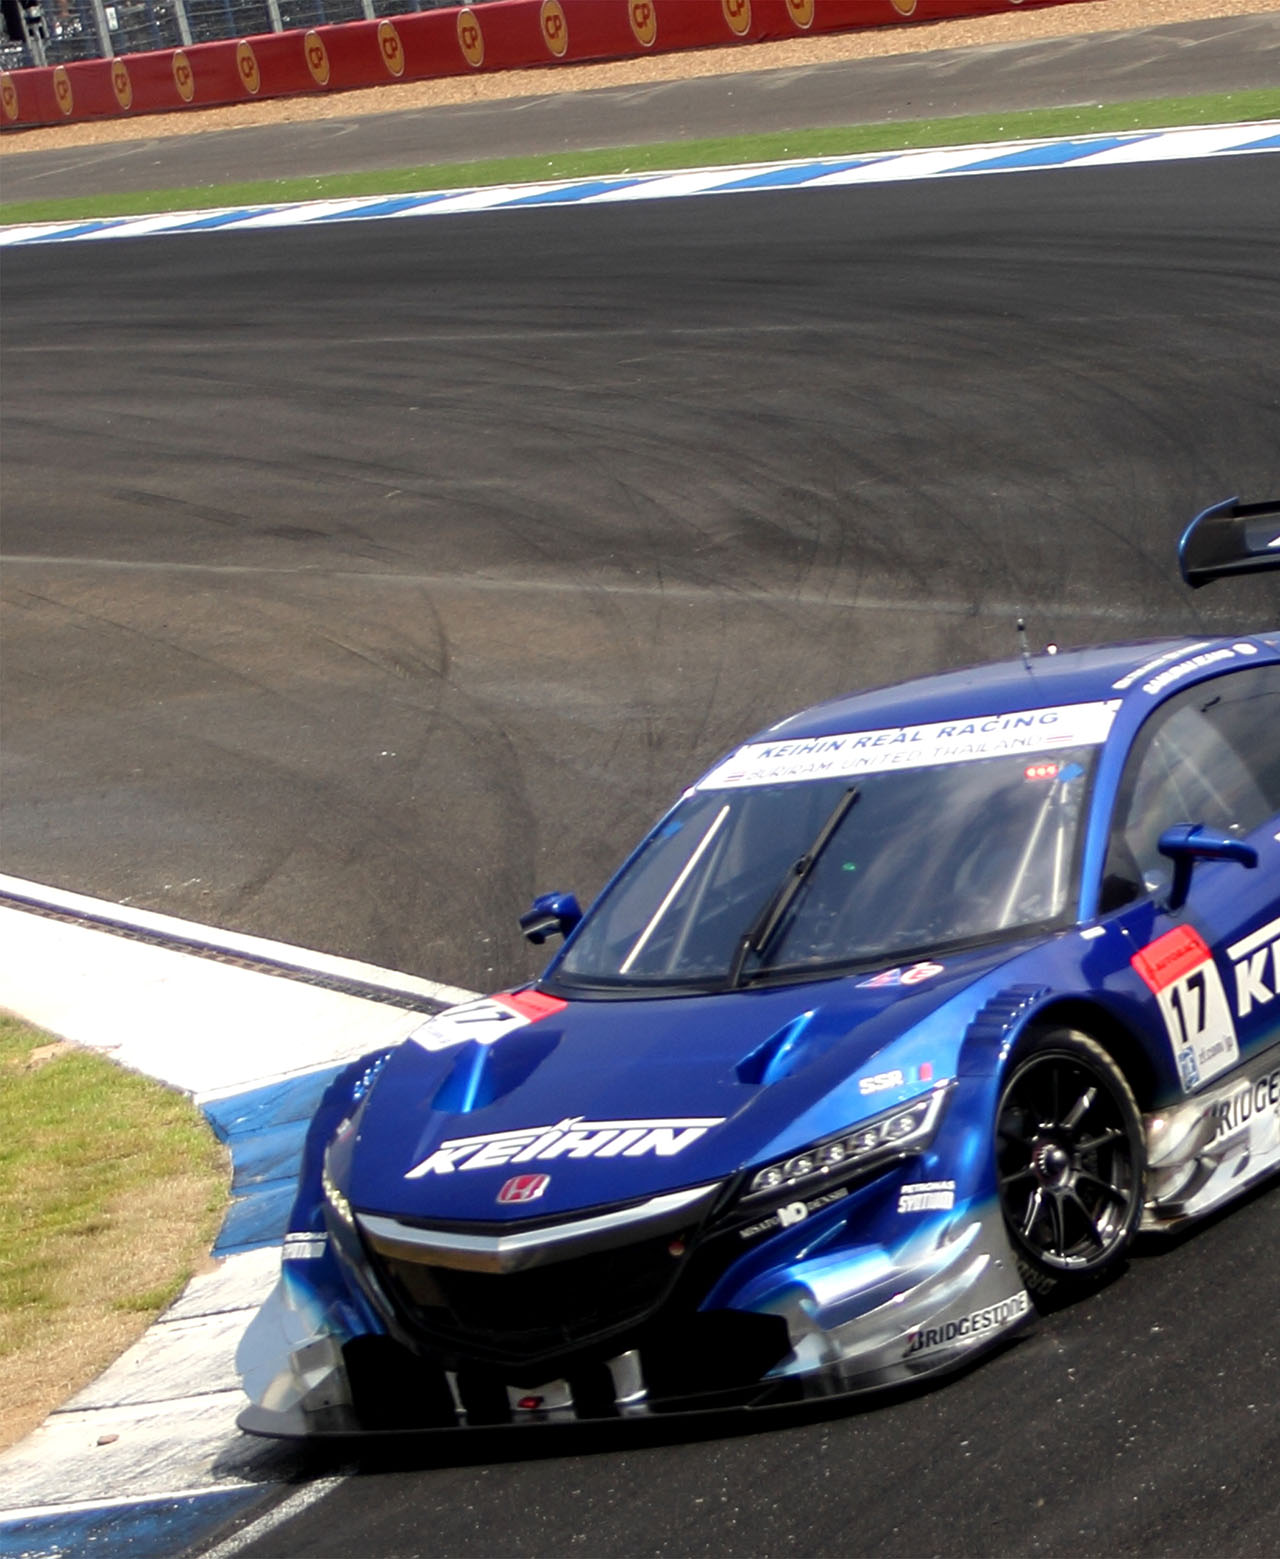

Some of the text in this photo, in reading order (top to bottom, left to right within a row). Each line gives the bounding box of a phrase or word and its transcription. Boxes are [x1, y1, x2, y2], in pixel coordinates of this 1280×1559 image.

[545, 15, 562, 39] CP
[633, 3, 650, 29] CP
[383, 37, 397, 60] CP
[462, 27, 478, 49] CP
[240, 56, 254, 78] CP
[309, 47, 323, 69] CP
[758, 712, 1060, 759] KEIHIN REAL RACING
[747, 736, 1042, 781] BURIRAM UNITED THAILAND
[1171, 970, 1206, 1043] 17
[404, 1116, 726, 1179] KEIHIN
[903, 1293, 1025, 1358] BRIDGESTONE
